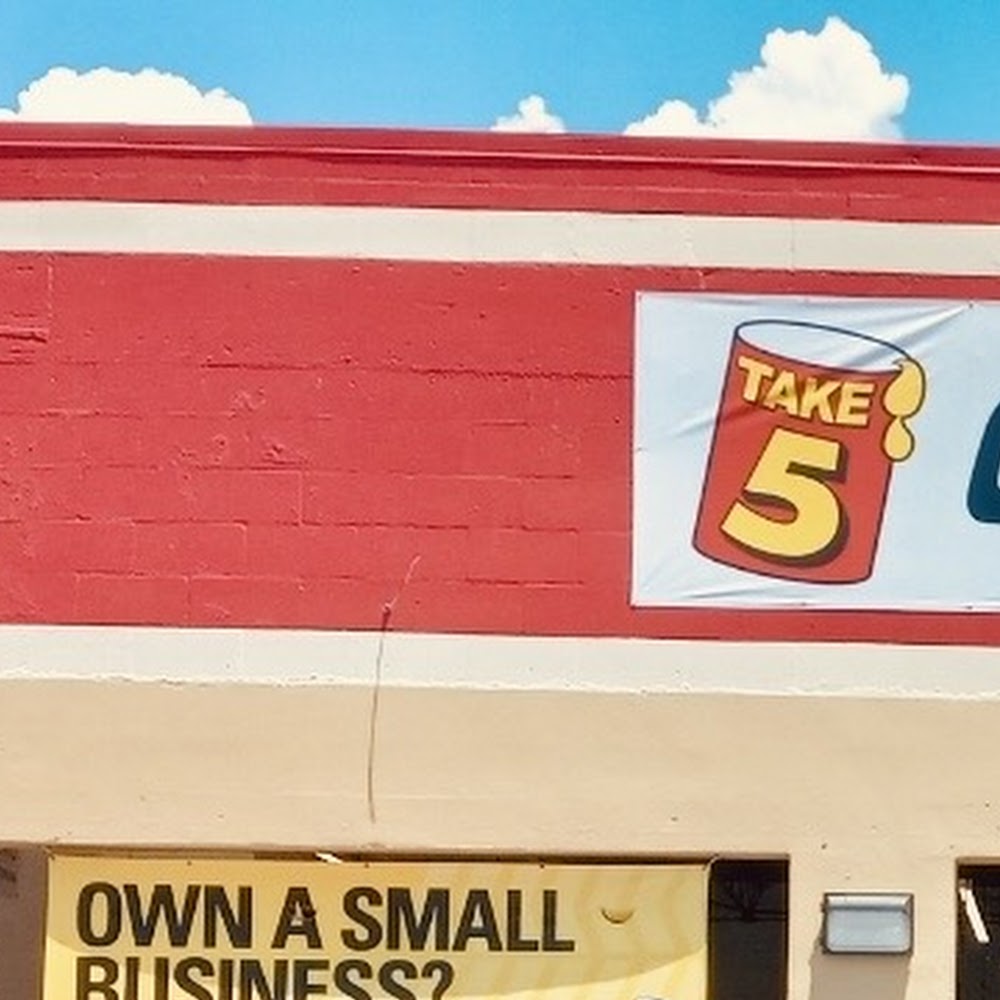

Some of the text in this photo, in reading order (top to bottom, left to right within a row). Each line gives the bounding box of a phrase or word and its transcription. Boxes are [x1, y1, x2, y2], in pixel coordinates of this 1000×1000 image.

[737, 356, 876, 427] TAKE
[719, 427, 849, 565] 5
[76, 882, 575, 952] OWN A SMALL
